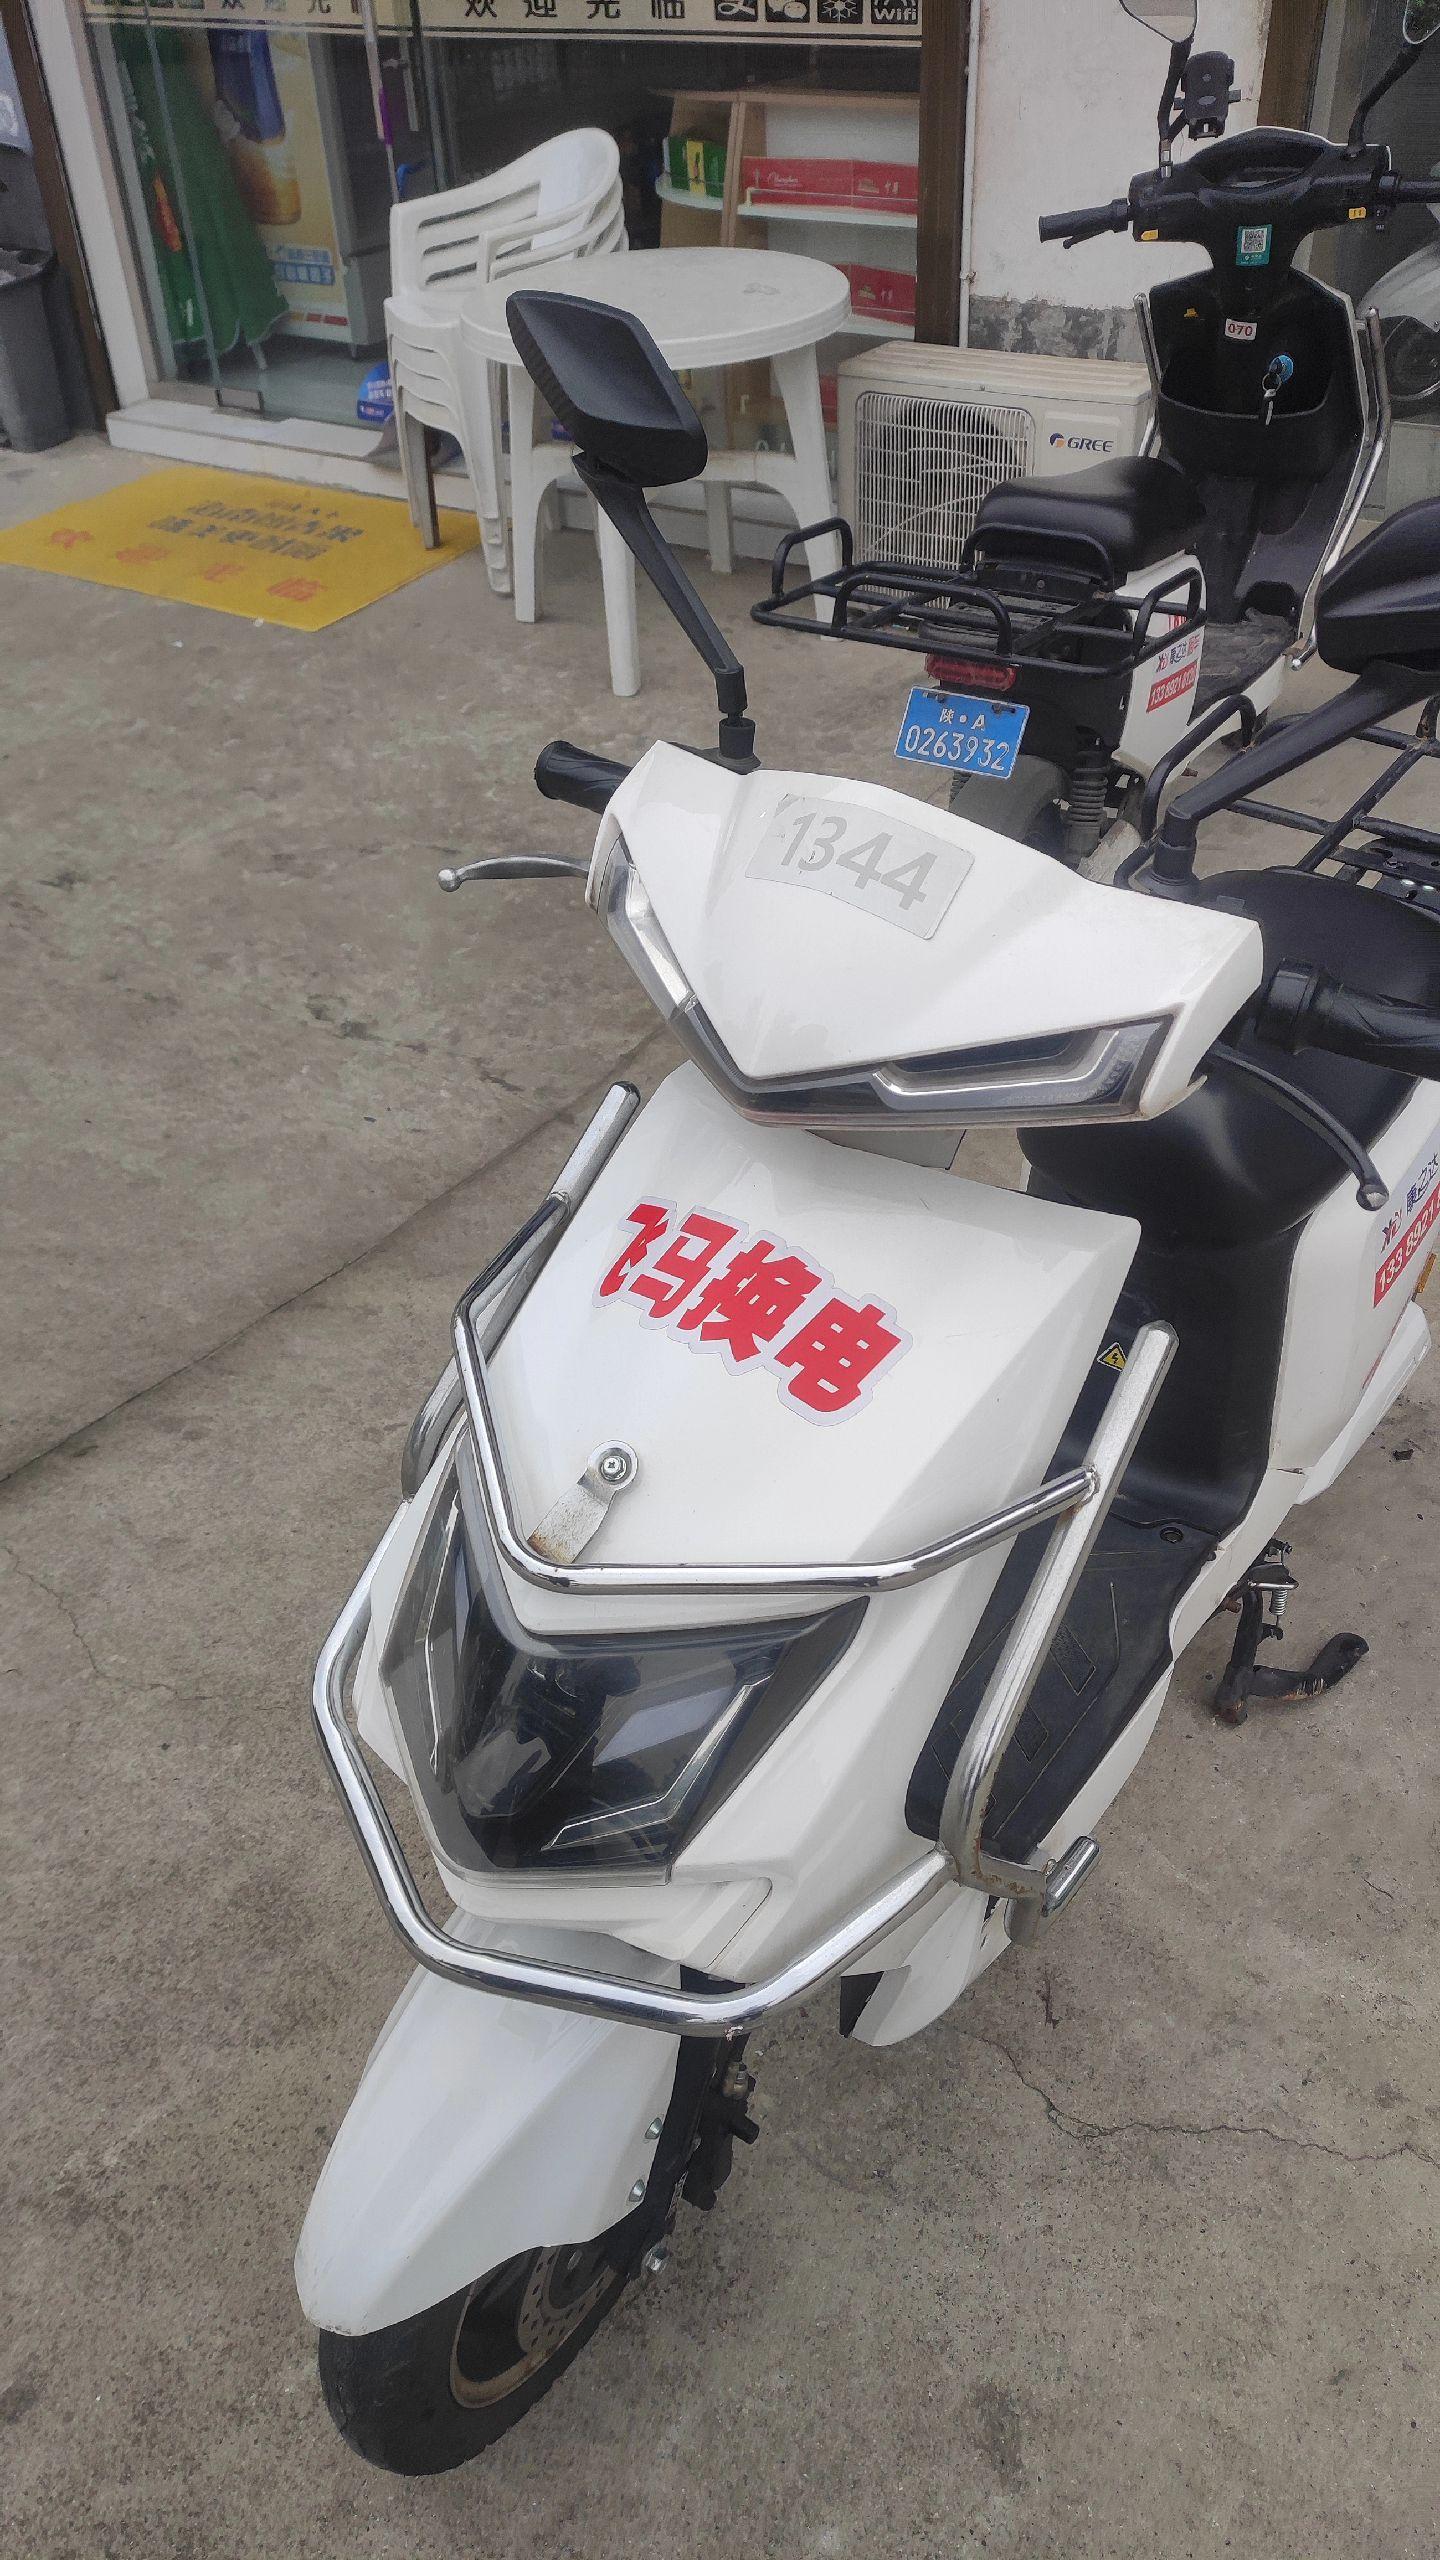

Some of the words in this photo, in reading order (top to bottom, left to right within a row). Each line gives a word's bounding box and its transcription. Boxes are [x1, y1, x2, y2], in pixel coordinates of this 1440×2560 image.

[1227, 323, 1253, 337] 070
[1067, 437, 1115, 453] GREE
[904, 724, 1010, 771] 0263932
[780, 812, 938, 911] 1344
